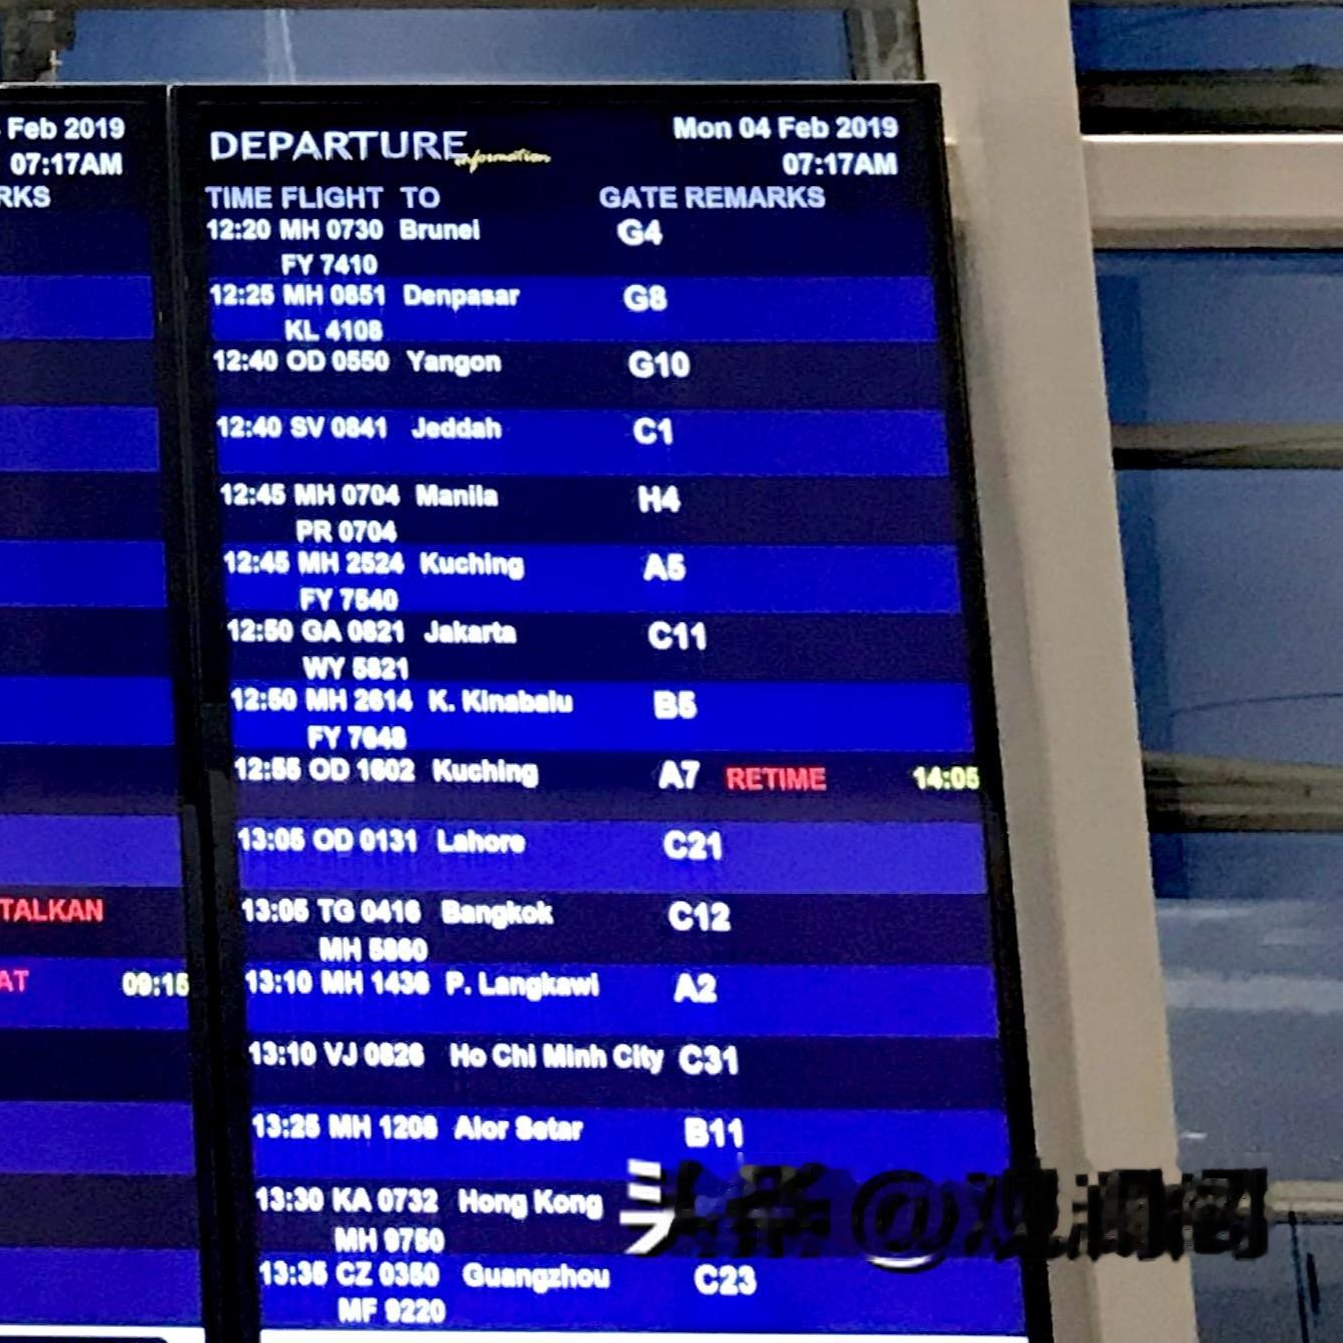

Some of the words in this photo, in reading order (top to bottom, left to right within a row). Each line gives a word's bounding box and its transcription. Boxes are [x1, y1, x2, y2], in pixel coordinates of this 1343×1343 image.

[8, 117, 57, 139] Feb
[65, 117, 124, 139] 2019
[674, 117, 732, 139] Mon
[740, 117, 771, 138] 04
[779, 117, 829, 138] Feb
[836, 117, 898, 138] 2019
[211, 131, 468, 161] DEPARTURE
[11, 153, 122, 175] 07:17AM
[783, 153, 897, 175] 07:17AM
[205, 187, 272, 208] TIME
[282, 186, 383, 209] FLIGHT
[400, 187, 440, 208] TO
[600, 187, 677, 208] GATE
[686, 186, 825, 208] REMARKS
[207, 219, 271, 240] 12:20
[280, 219, 319, 239] MH
[327, 219, 383, 239] 0730
[400, 219, 480, 240] Brunei
[618, 219, 662, 245] G4
[282, 254, 313, 275] FY
[321, 254, 377, 275] 7410
[407, 350, 501, 377] Yangon
[629, 351, 690, 378] G10
[412, 417, 501, 438] Jeddah
[634, 417, 672, 444] C1
[433, 759, 538, 788] Kuching
[659, 760, 700, 789] A7
[726, 767, 826, 791] RETIME
[913, 766, 980, 789] 14:05
[437, 829, 525, 853] Lahore
[663, 830, 722, 860] C21
[450, 1043, 487, 1067] Ho
[492, 1044, 536, 1068] Chi
[543, 1044, 607, 1068] Minh
[613, 1044, 664, 1074] City
[679, 1044, 738, 1074] C31
[685, 1117, 743, 1148] B11
[463, 1262, 610, 1293] Guangzhou
[695, 1264, 757, 1295] C23
